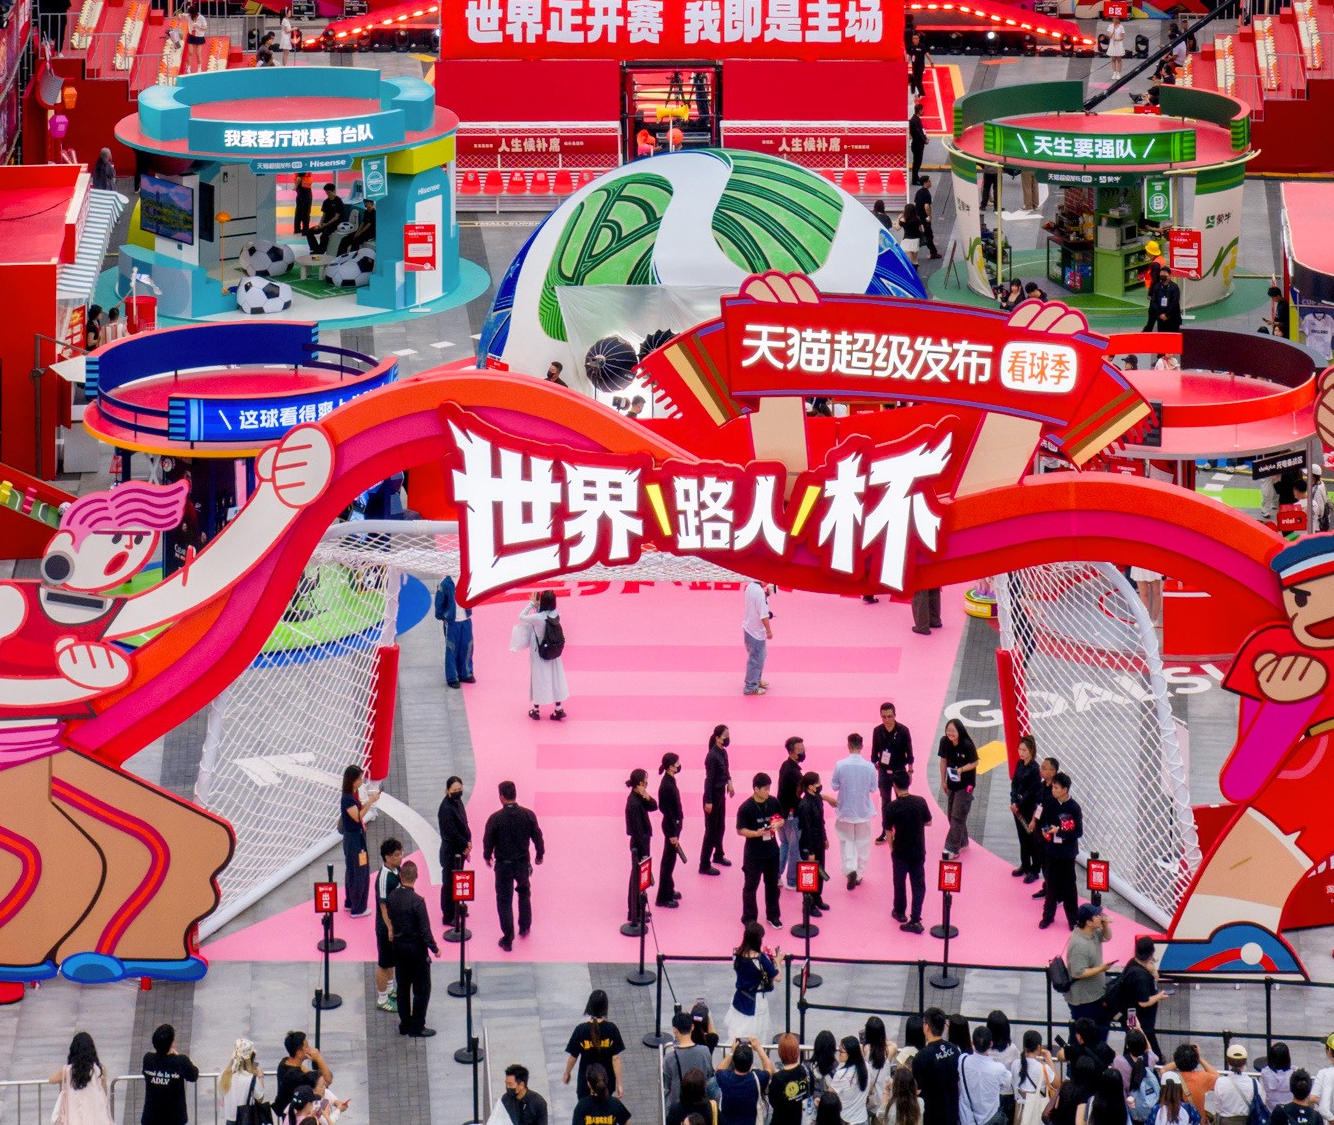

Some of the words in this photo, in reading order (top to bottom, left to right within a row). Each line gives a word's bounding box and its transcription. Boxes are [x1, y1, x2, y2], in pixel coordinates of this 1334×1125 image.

[224, 125, 373, 148] 我家客厅就是看台队
[498, 136, 560, 153] 人生候补席
[778, 136, 841, 153] 人生候补席
[1033, 135, 1136, 159] 天生要强队
[310, 159, 347, 168] Hisense
[418, 184, 441, 195] Hisense
[742, 324, 993, 384] 天猫超级发布
[1008, 348, 1070, 385] 看球季
